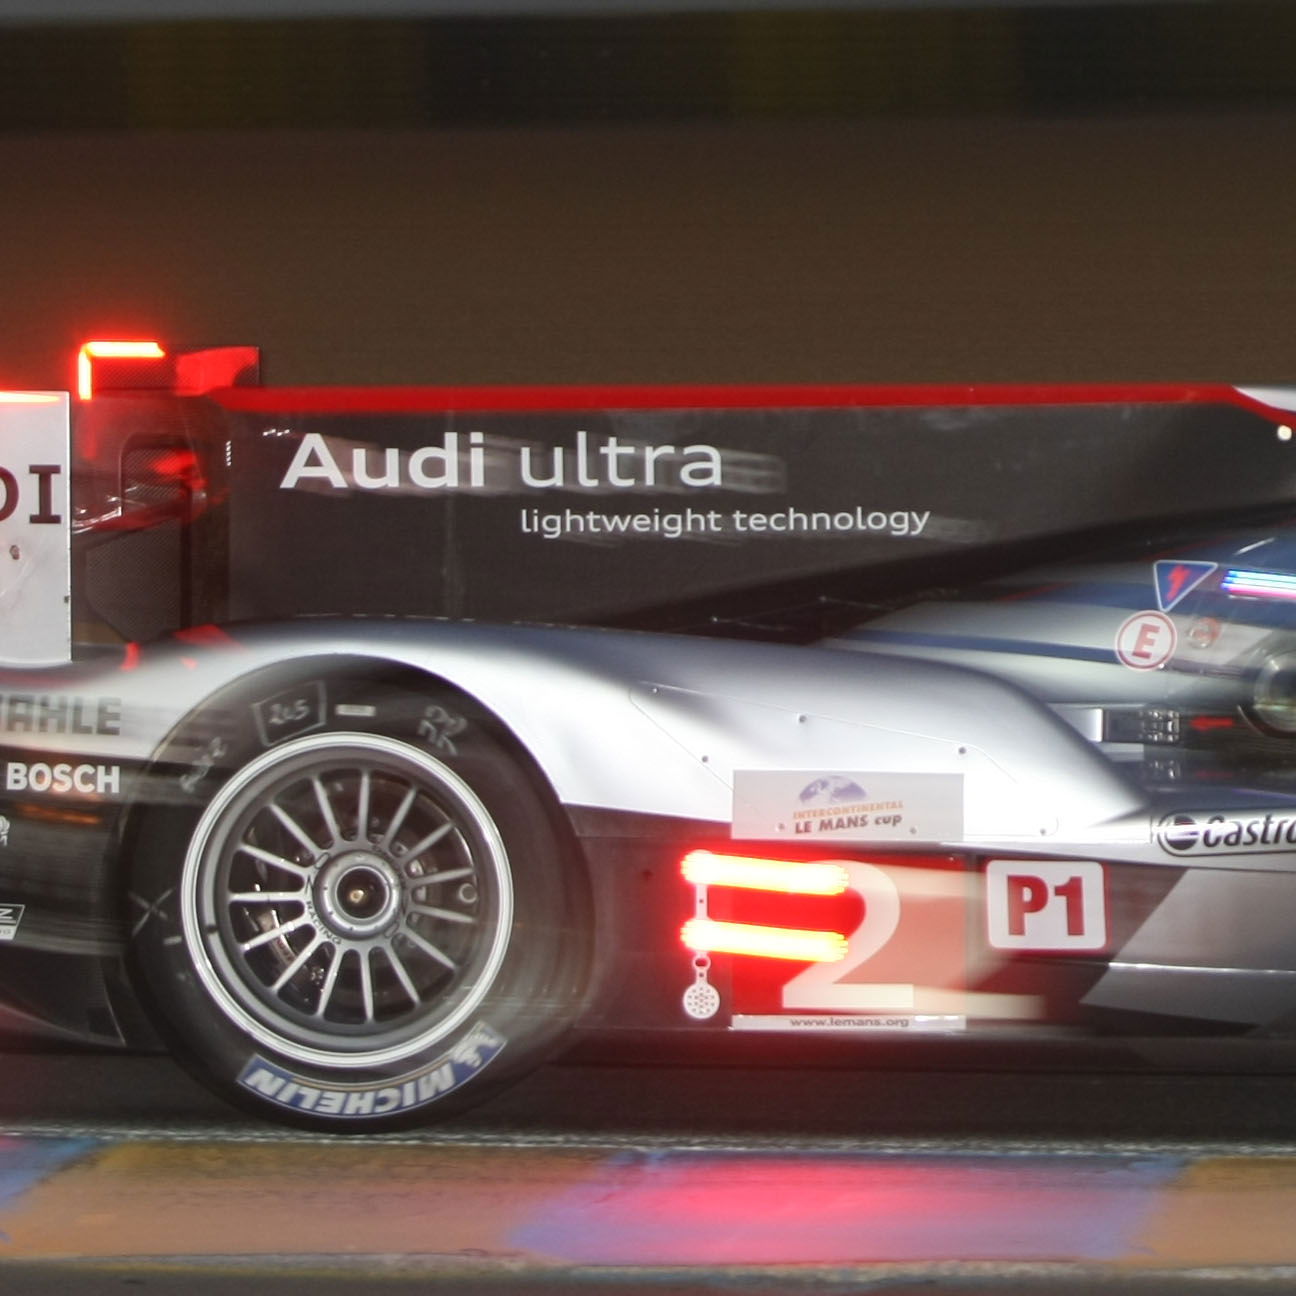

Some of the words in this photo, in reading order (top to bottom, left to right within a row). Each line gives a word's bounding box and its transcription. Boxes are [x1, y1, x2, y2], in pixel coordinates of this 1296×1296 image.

[280, 432, 485, 490] Audi
[519, 431, 722, 489] ultra
[521, 507, 722, 540] lightweight
[733, 507, 931, 536] technology
[1131, 623, 1161, 660] E
[0, 694, 121, 736] AHLE
[6, 761, 121, 794] BOSCH
[792, 800, 904, 820] INTERCONTINENTAL
[795, 820, 813, 835] LE
[818, 813, 868, 832] MANS
[875, 813, 904, 827] cup
[1006, 874, 1085, 936] P1
[782, 859, 914, 1009] 2
[789, 1016, 910, 1028] www.lemans.org
[245, 1061, 457, 1115] MICHELIN
